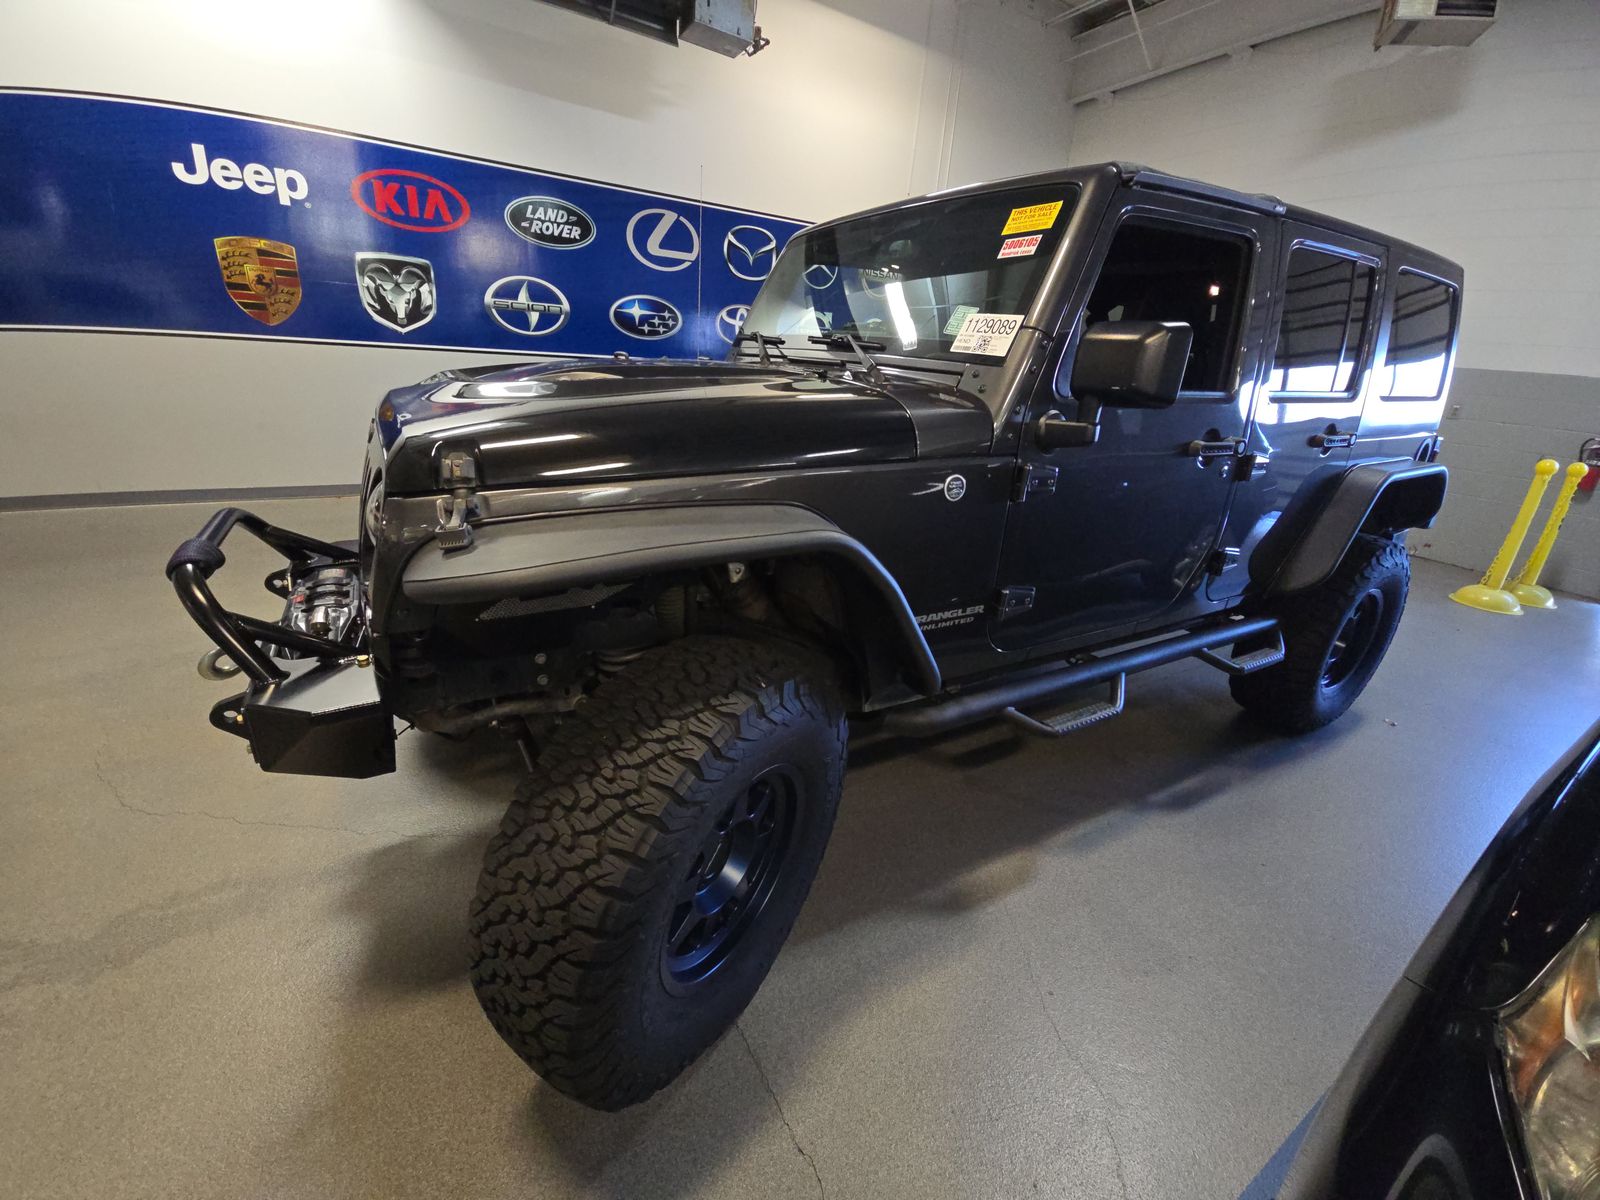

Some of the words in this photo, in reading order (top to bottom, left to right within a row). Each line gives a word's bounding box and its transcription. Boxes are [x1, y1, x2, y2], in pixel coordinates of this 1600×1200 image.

[171, 143, 308, 206] Jeep
[371, 179, 453, 223] KIA
[1029, 204, 1057, 213] VEHICLE
[526, 205, 567, 223] LAND
[531, 220, 581, 240] ROVER
[1003, 236, 1040, 250] 5006105
[863, 269, 899, 279] NISSAN
[493, 301, 563, 314] SCION
[966, 318, 1017, 335] 1129089
[915, 605, 984, 624] RANGLER
